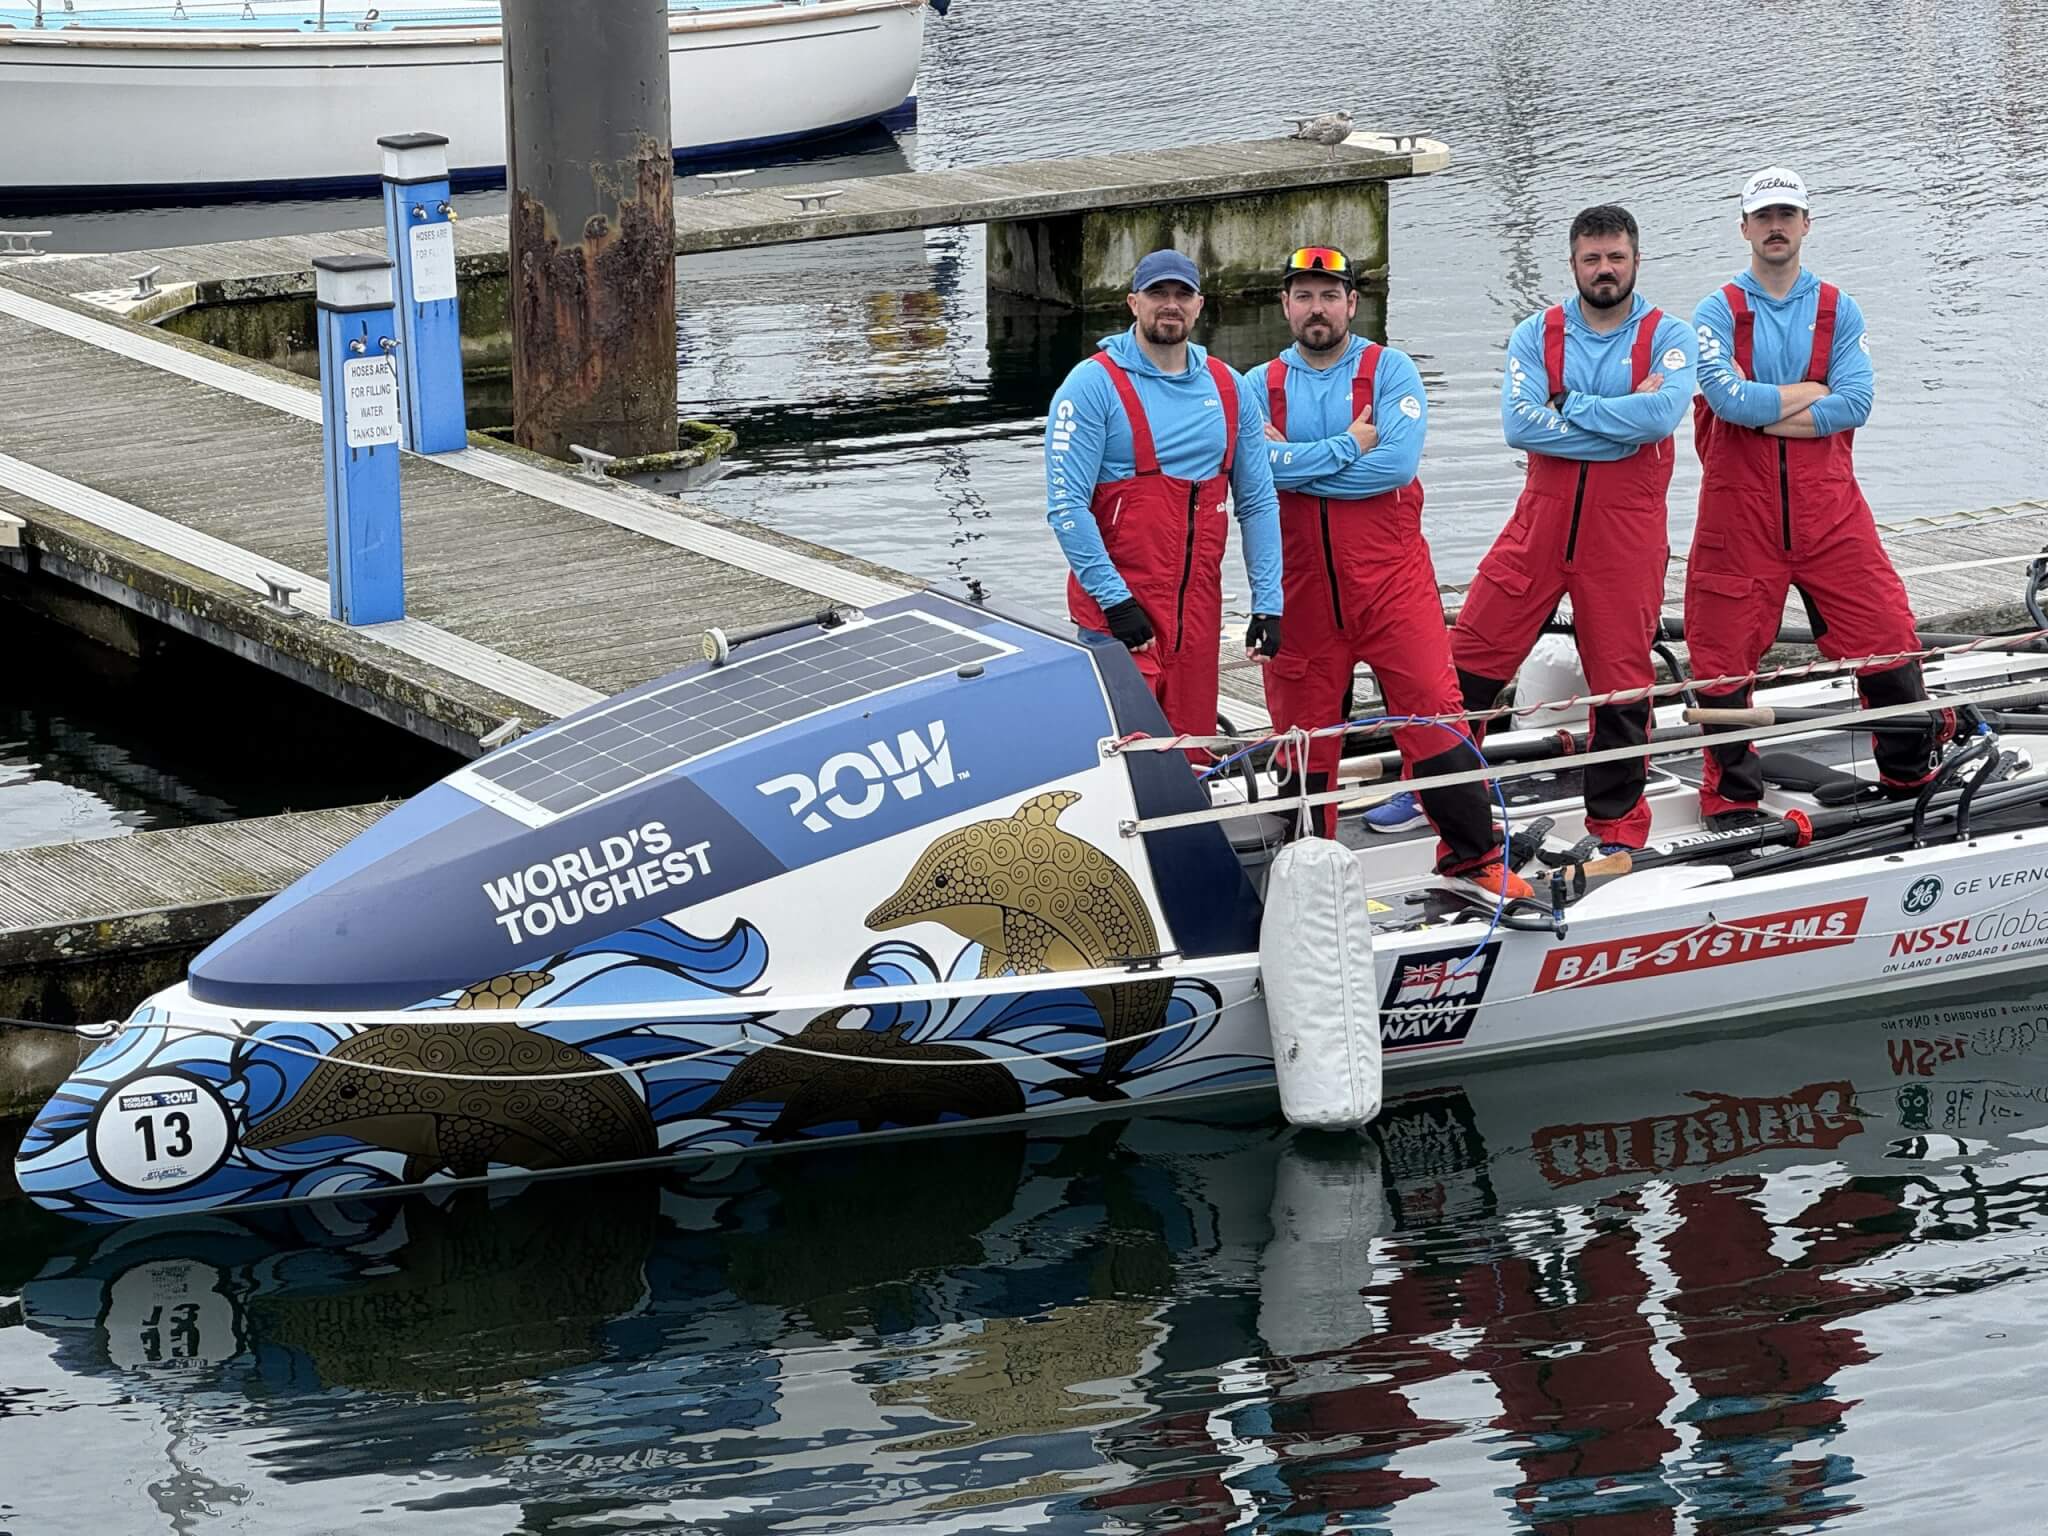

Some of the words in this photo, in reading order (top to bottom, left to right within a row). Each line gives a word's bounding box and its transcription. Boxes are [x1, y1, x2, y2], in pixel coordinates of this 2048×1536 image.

[1750, 177, 1799, 195] Titleist
[351, 364, 374, 377] HOSES
[375, 363, 389, 375] ARE
[351, 386, 365, 398] FOR
[366, 384, 391, 397] FILLING
[361, 406, 384, 418] WATER
[1052, 399, 1077, 451] Gill
[353, 427, 375, 440] TANKS
[376, 424, 393, 438] ONLY
[755, 719, 956, 833] ROW
[482, 821, 672, 913] WORLD'S
[496, 840, 713, 945] TOUGHEST
[1953, 878, 1982, 896] GE
[1555, 945, 1642, 982] BAE
[1653, 911, 1849, 966] SYSTEMS
[1882, 963, 1899, 974] ON
[1901, 958, 1932, 971] LAND
[1945, 945, 1998, 963] ONBOARD
[1386, 998, 1467, 1023] ROYAL
[1381, 1014, 1464, 1040] NAVY
[134, 1111, 193, 1162] 13
